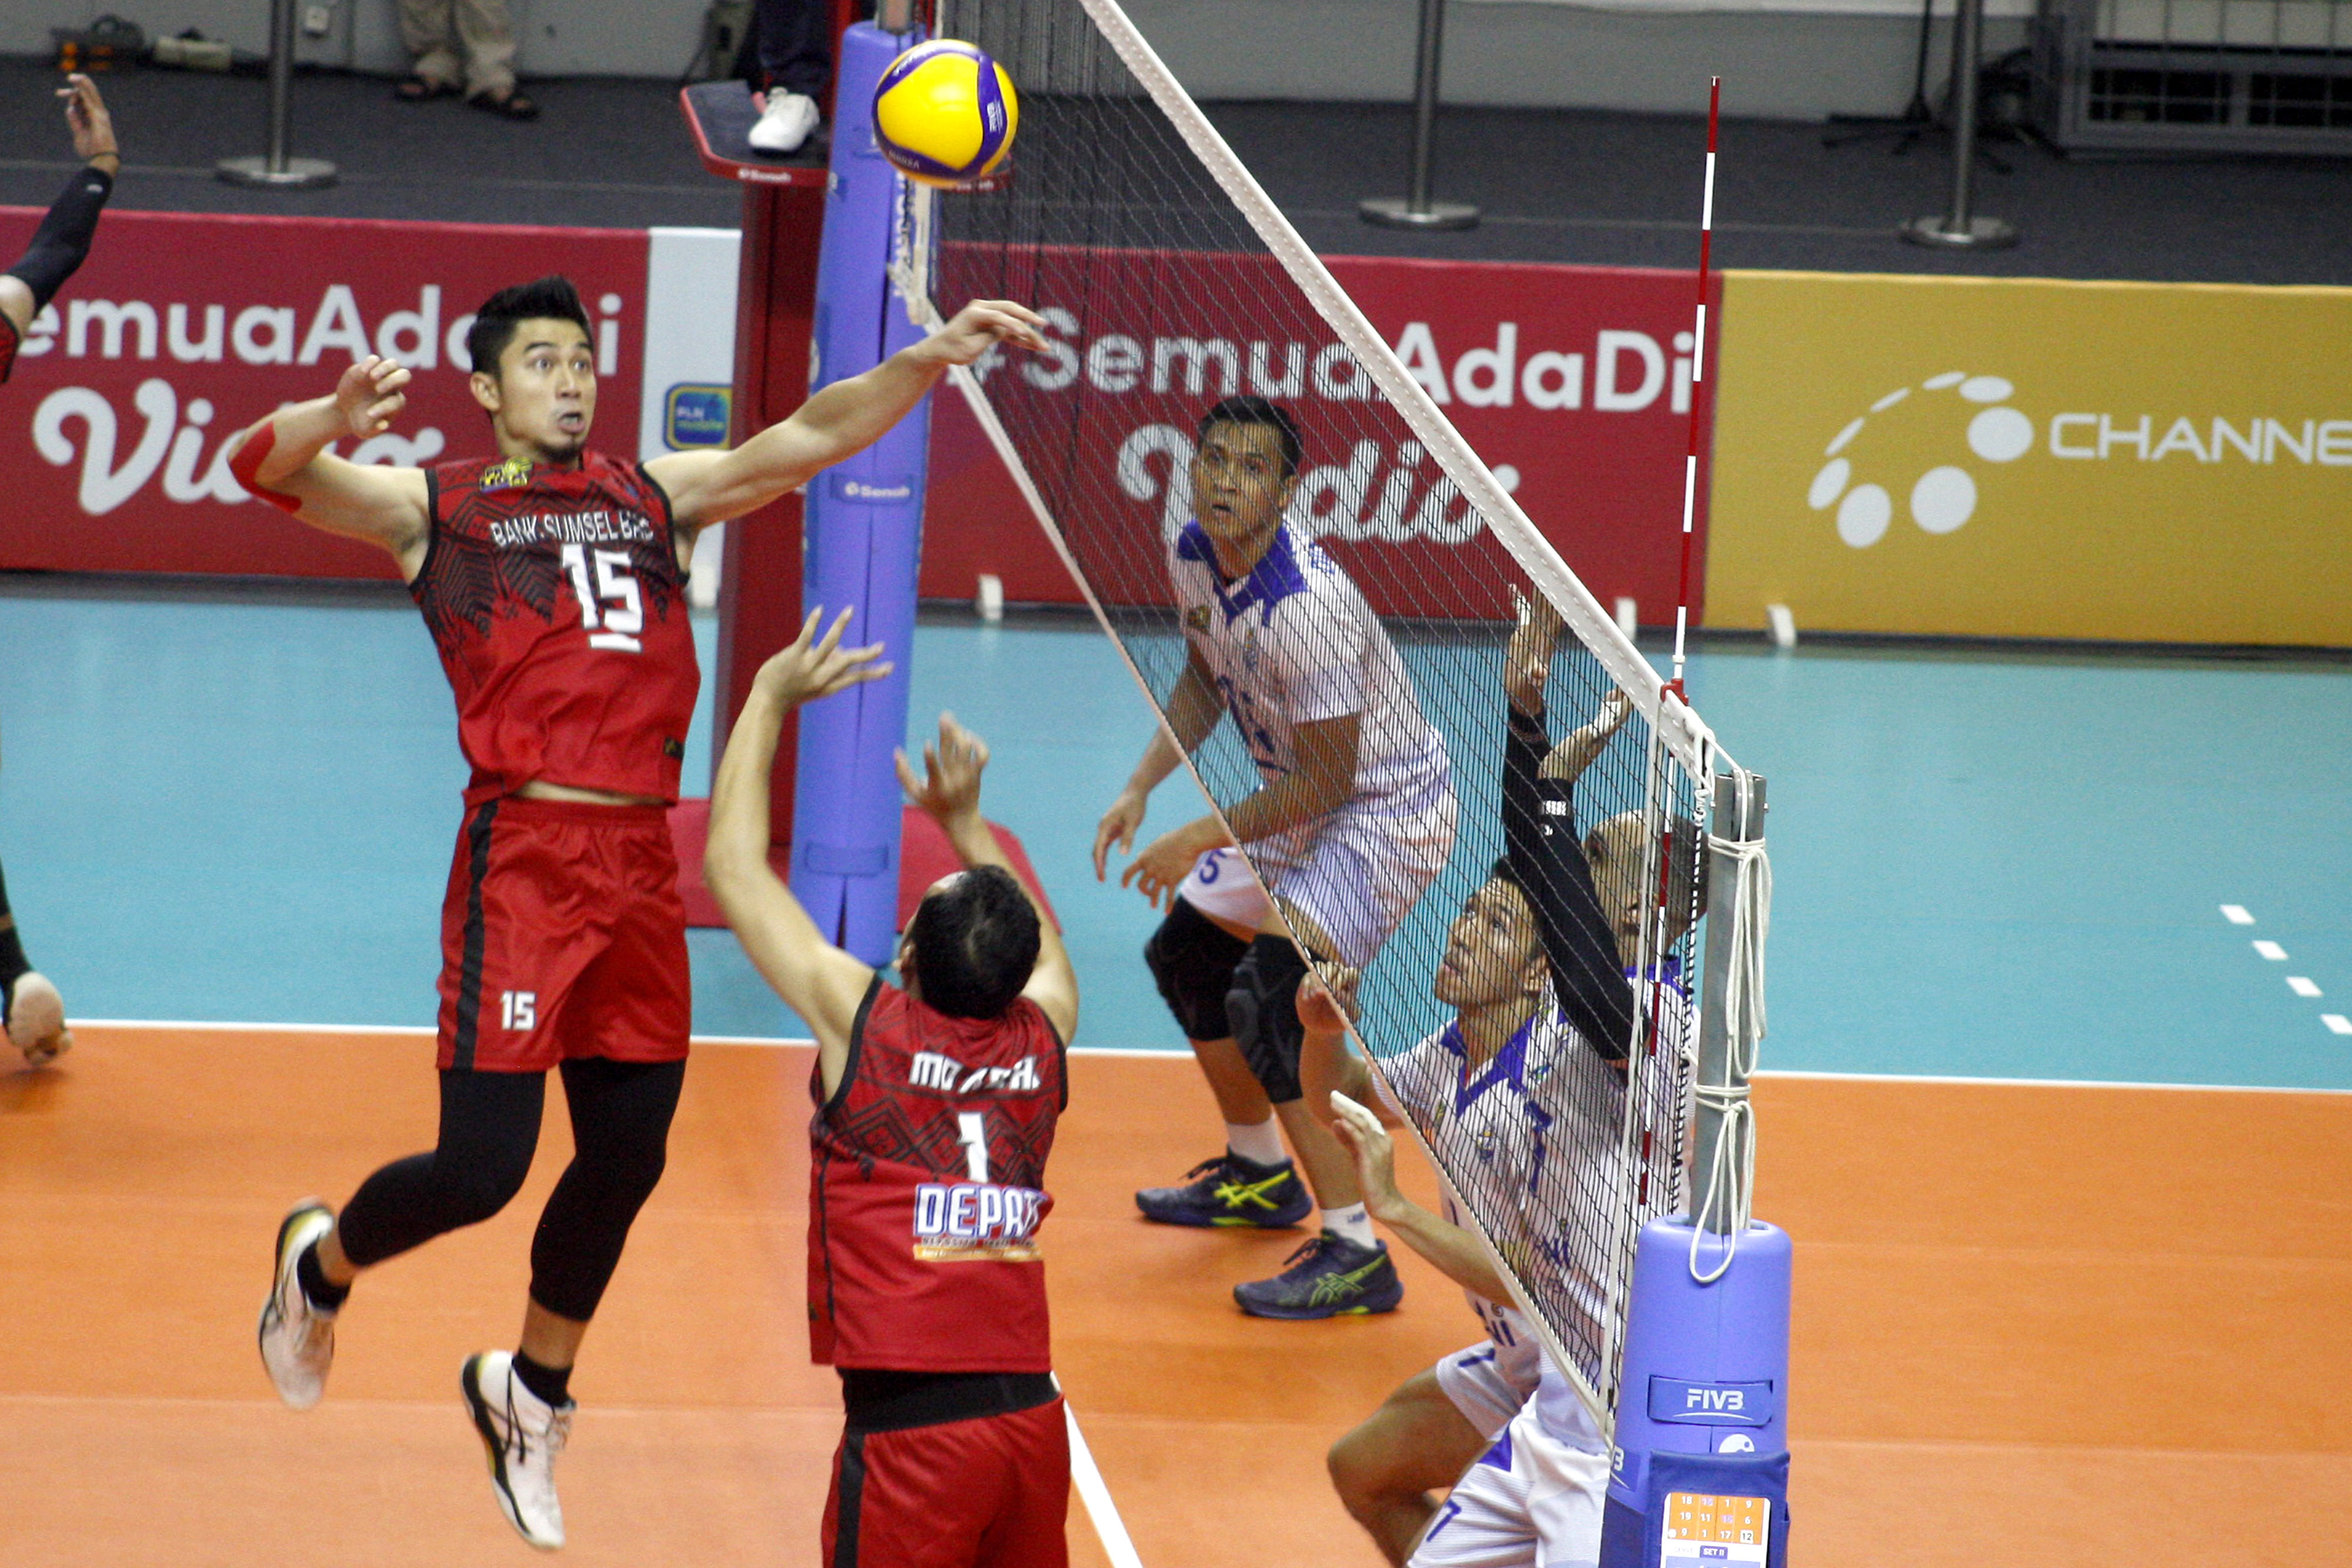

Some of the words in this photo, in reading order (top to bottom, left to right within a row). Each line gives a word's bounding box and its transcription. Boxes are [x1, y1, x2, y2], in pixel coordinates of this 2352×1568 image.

[490, 514, 537, 547] BANK
[561, 543, 644, 634] 15
[501, 991, 536, 1030] 15
[957, 1111, 989, 1183] 1
[1686, 1388, 1744, 1410] FIVB
[1682, 1496, 1693, 1505] 18
[1725, 1499, 1730, 1507] 1
[1681, 1512, 1692, 1520] 19
[1745, 1516, 1752, 1524] 6
[1681, 1528, 1688, 1536] 9
[1720, 1530, 1732, 1539] 17
[1703, 1548, 1718, 1556] SET
